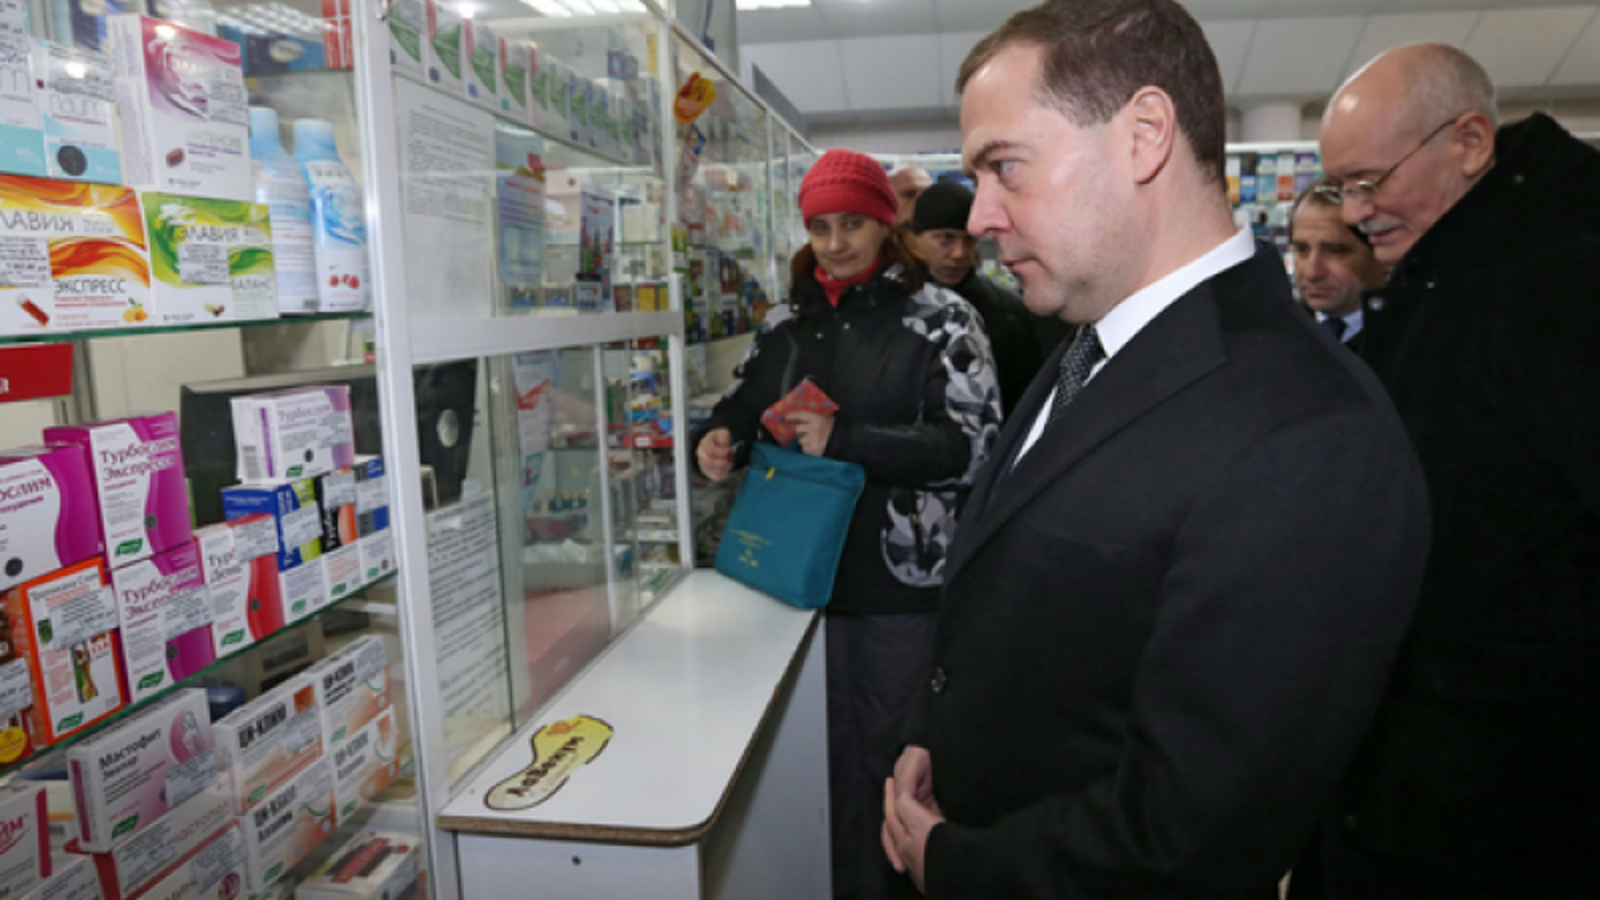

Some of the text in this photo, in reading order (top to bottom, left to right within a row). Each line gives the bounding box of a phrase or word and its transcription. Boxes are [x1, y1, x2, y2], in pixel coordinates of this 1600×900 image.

[53, 278, 126, 294] ЭКСПРЕСС
[101, 439, 176, 466] Турбослим
[124, 568, 198, 603] Турбослим
[239, 703, 287, 749] ЦИ-КЛИМ
[98, 728, 162, 770] Мастофит
